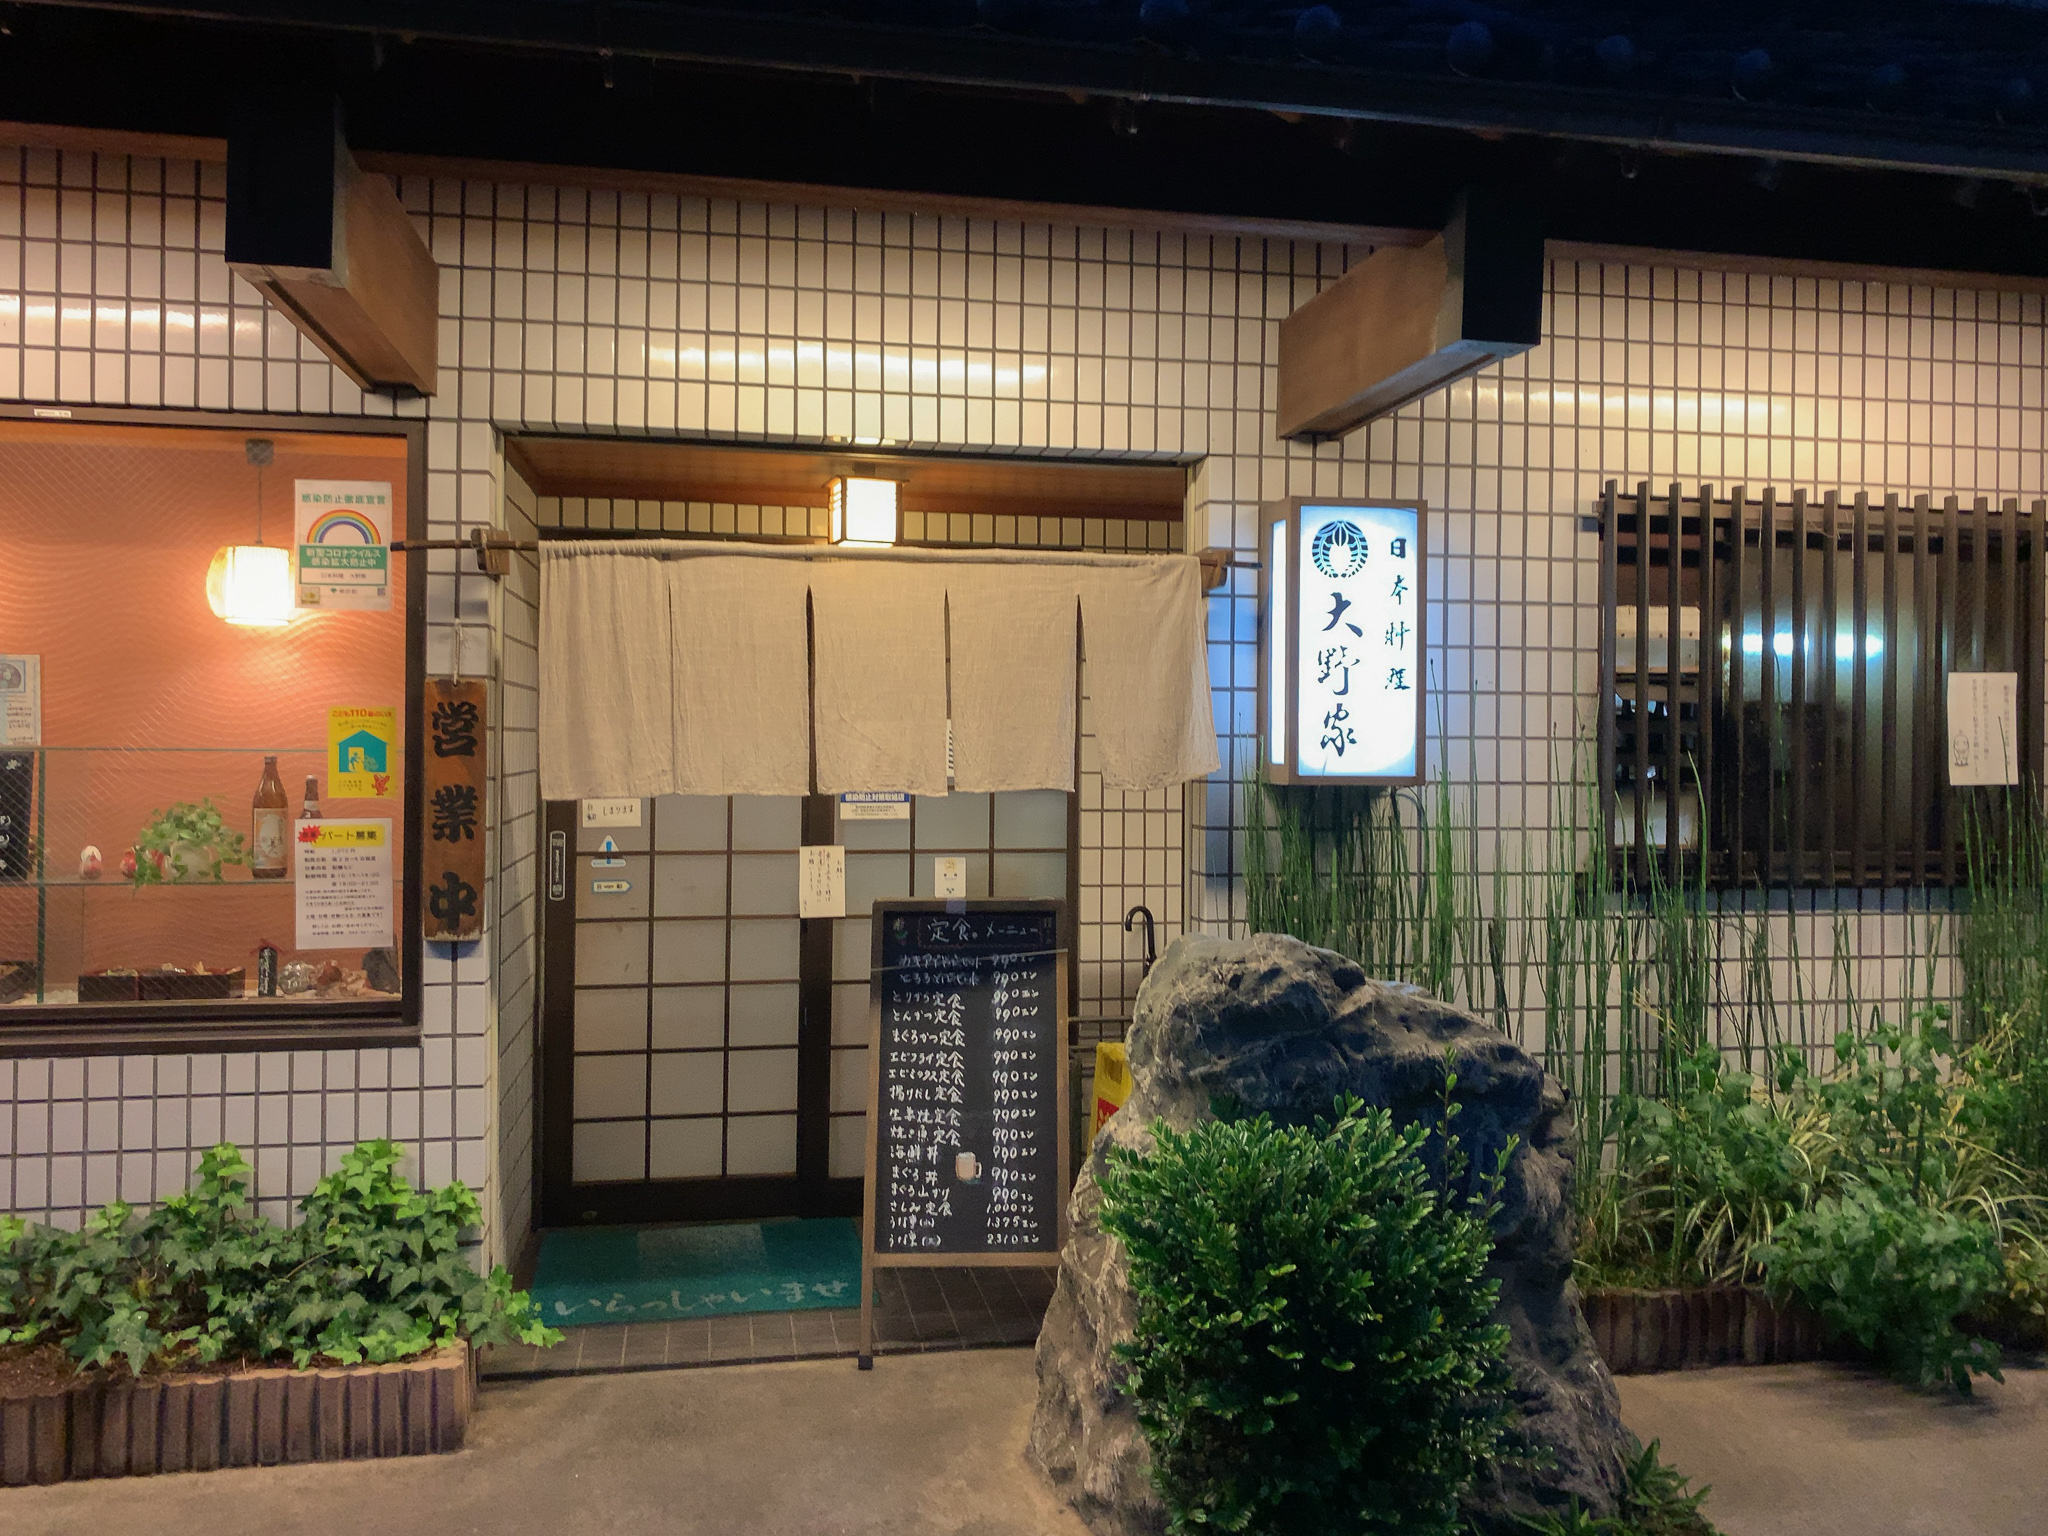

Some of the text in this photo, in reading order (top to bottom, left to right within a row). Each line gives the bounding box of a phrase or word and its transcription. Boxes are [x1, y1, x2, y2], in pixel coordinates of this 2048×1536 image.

[306, 548, 381, 558] 新型コロナウイルス
[311, 557, 377, 568] 感染拡大防止中
[1384, 537, 1411, 691] 日本料理
[1318, 592, 1363, 757] 大野家
[430, 701, 479, 930] 営業中
[321, 830, 377, 841] パート募集
[890, 1050, 965, 1070] エビフライ定食
[890, 1144, 939, 1165] 海鮮丼
[554, 1280, 849, 1317] いらっしゃいませ
